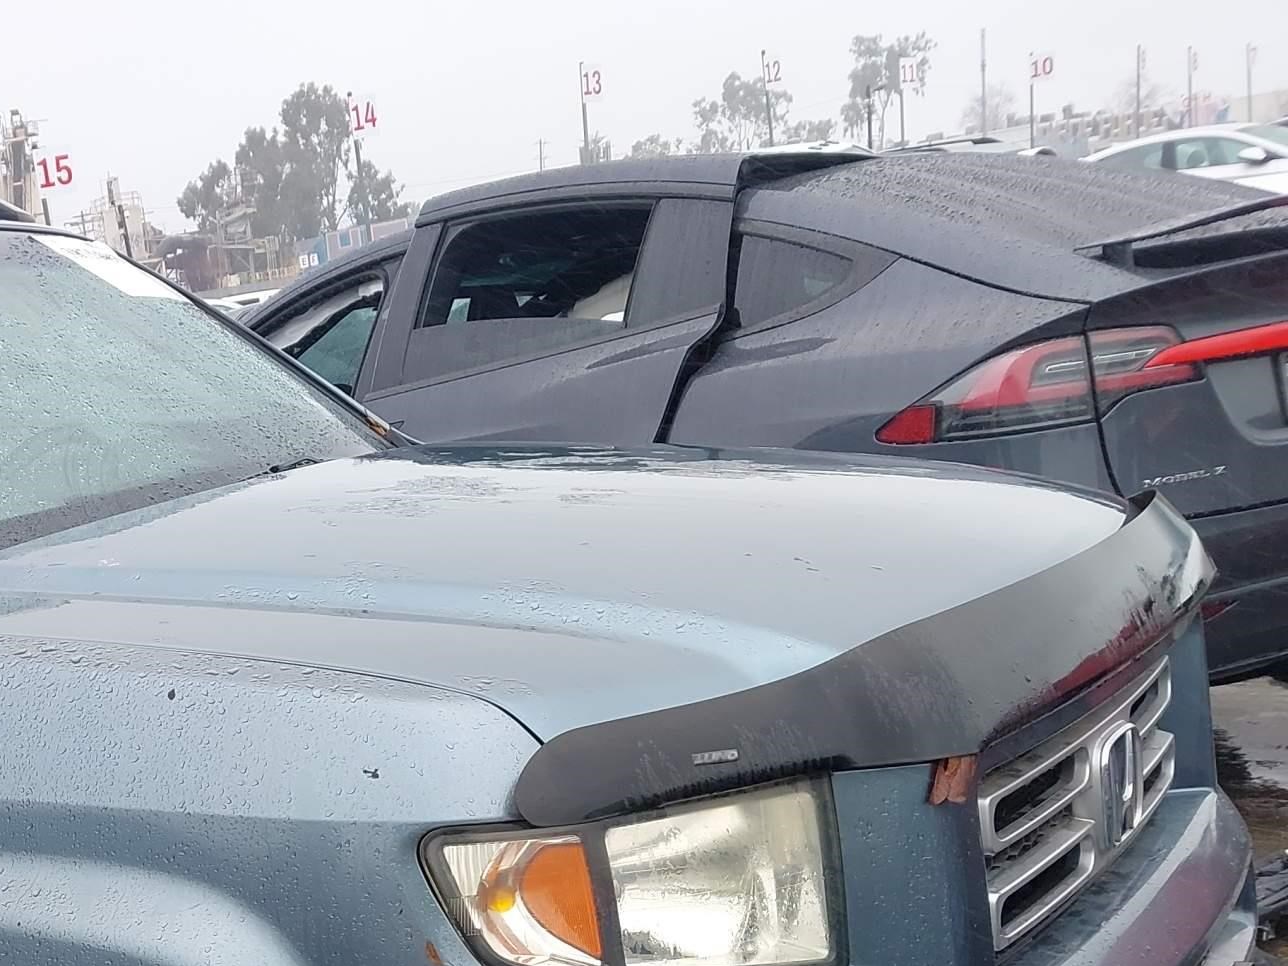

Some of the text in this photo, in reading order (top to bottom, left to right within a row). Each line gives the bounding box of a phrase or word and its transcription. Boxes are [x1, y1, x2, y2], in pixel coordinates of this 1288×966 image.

[765, 60, 782, 84] 12
[901, 63, 916, 83] 11
[1031, 56, 1054, 78] 10
[583, 70, 602, 96] 13
[352, 101, 377, 131] 14
[36, 154, 73, 189] 15
